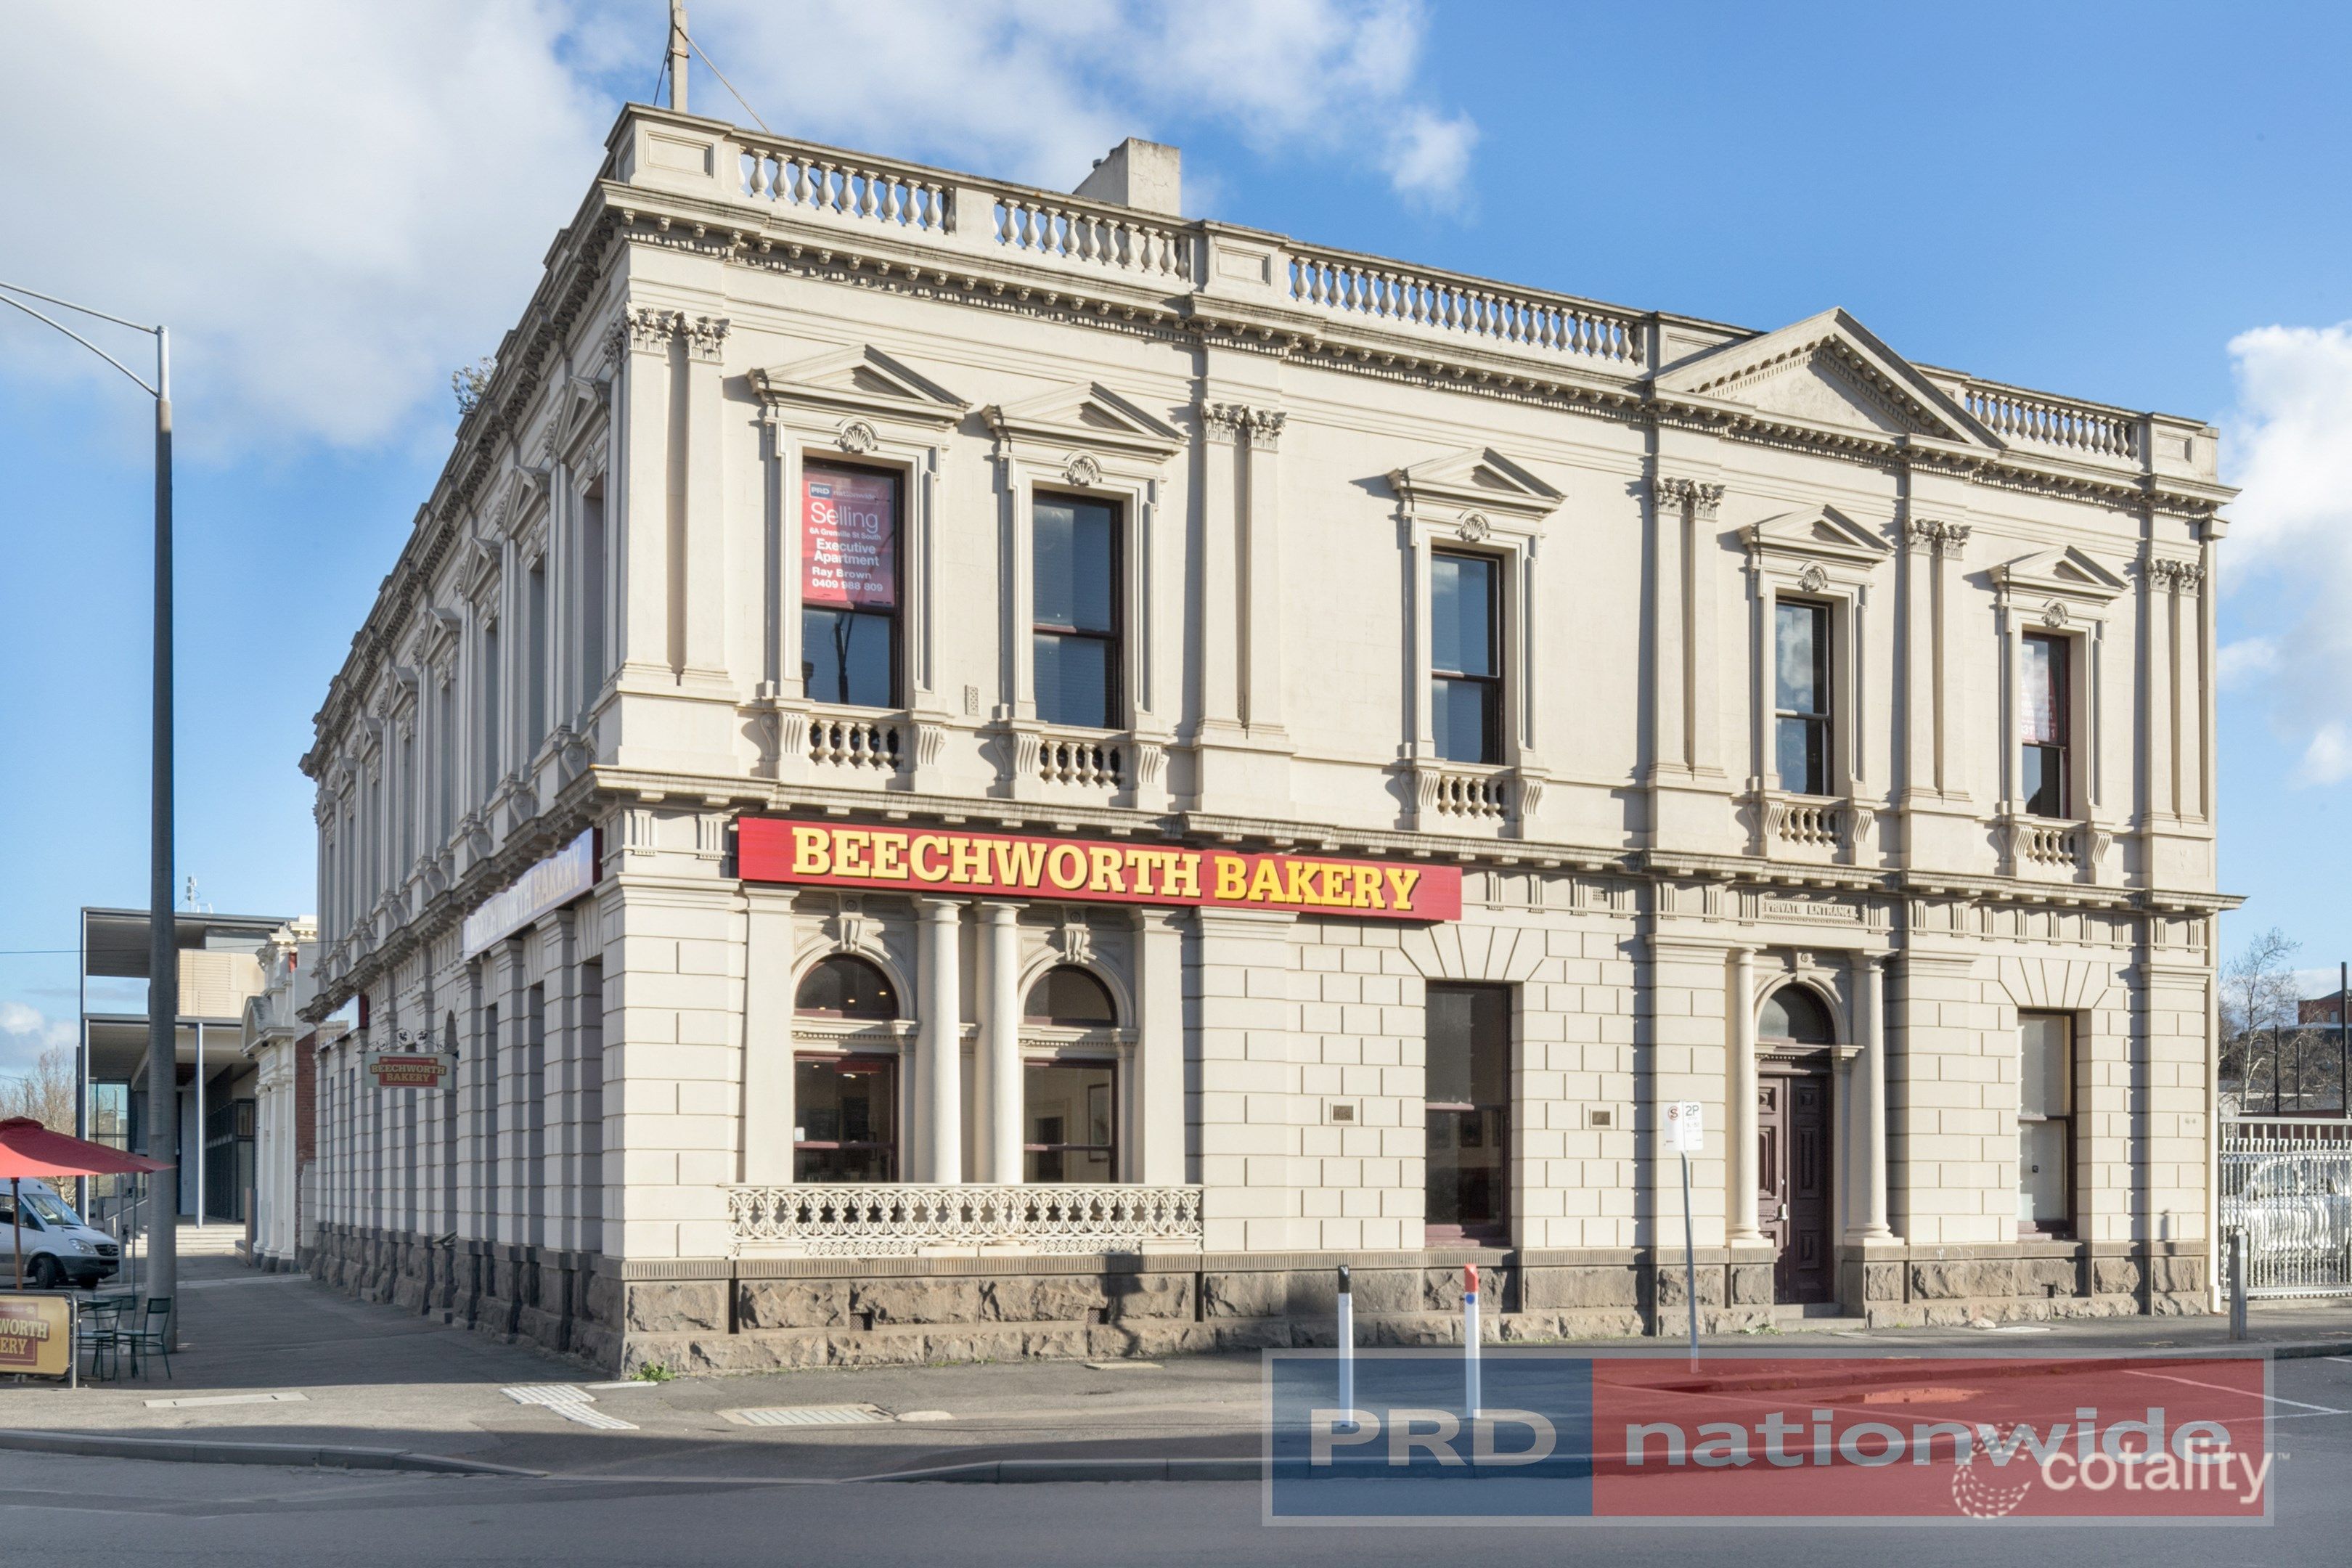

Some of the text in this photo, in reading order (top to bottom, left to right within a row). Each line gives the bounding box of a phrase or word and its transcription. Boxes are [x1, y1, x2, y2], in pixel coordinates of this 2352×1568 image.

[833, 491, 875, 499] nationwide
[811, 502, 878, 534] Selling
[821, 528, 850, 538] Grenville
[817, 538, 876, 554] Executive
[814, 550, 879, 566] Apartment
[812, 566, 871, 580] Ray Brown
[812, 579, 838, 588] 0409
[792, 826, 1419, 910] BEECHWORTH BAKERY
[1765, 902, 1802, 914] PRIVATE
[372, 1064, 445, 1074] BEECHWORTH
[386, 1073, 429, 1082] BAKERY
[1686, 1105, 1699, 1116] 2P
